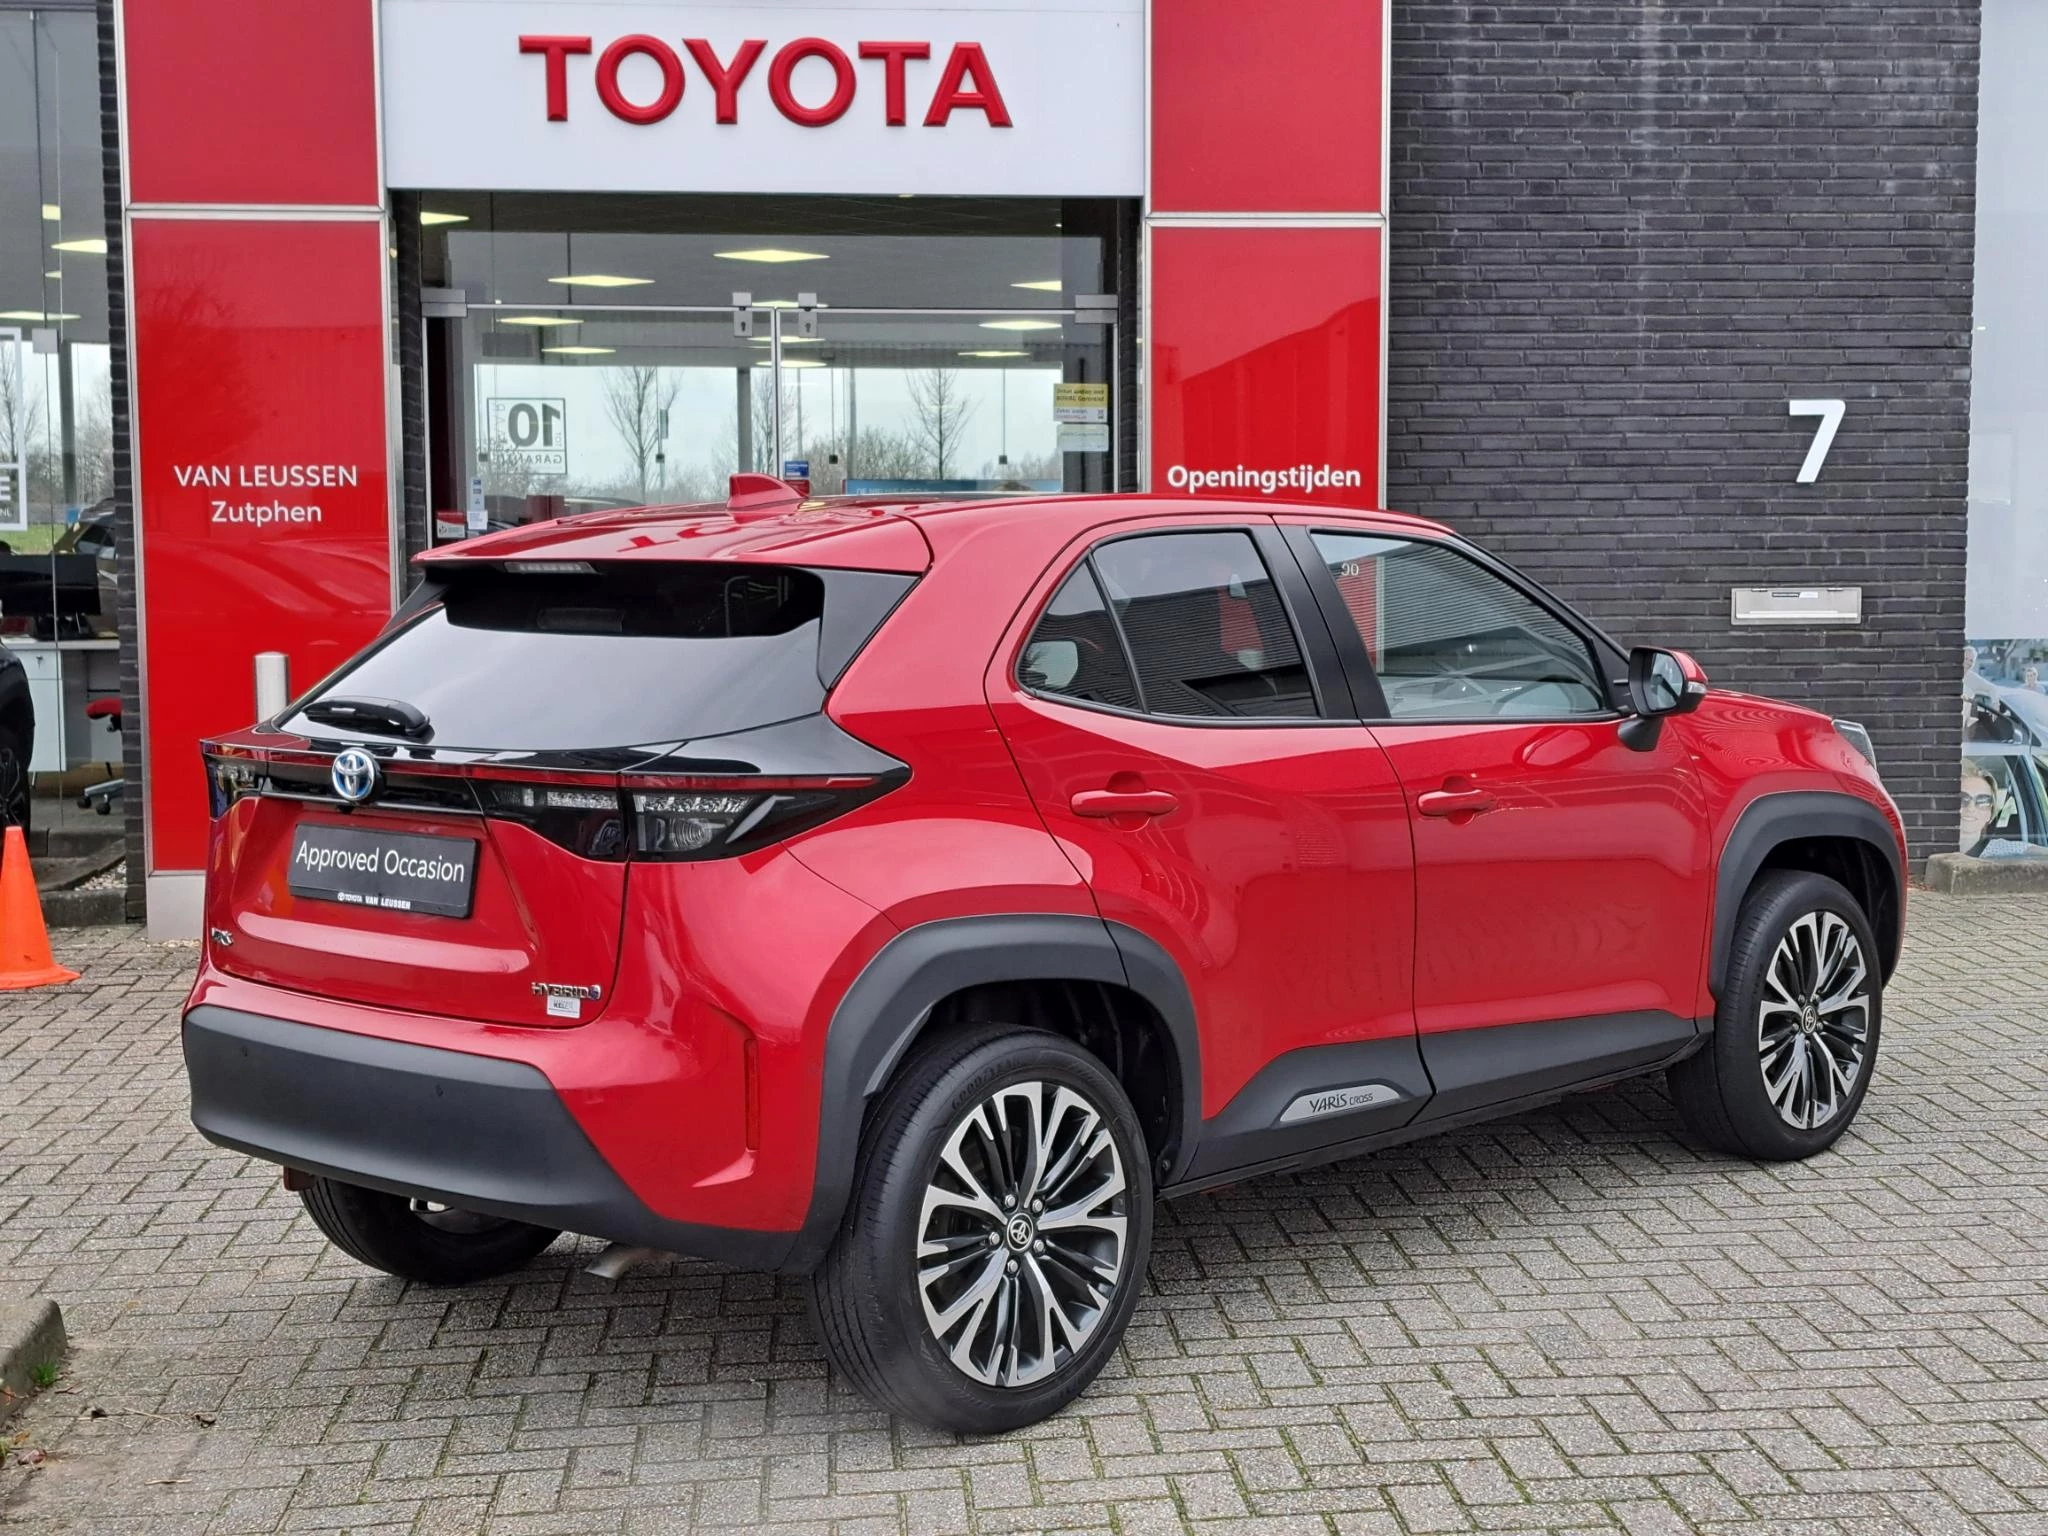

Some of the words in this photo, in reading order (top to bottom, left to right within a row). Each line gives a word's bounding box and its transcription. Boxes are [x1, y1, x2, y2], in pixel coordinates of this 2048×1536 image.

[519, 35, 1012, 128] TOYOTA
[1788, 399, 1845, 483] 7
[174, 466, 231, 487] VAN
[240, 466, 357, 487] LEUSSEN
[1168, 464, 1361, 494] Openingstijden
[211, 500, 322, 527] Zutphen
[296, 840, 380, 872] Approved
[384, 850, 465, 883] Occasion
[365, 895, 379, 906] VAN
[381, 897, 411, 910] LEUSSEN
[531, 982, 588, 999] HYBRID
[1309, 1093, 1347, 1113] YARIS
[1349, 1092, 1374, 1106] CROSS
